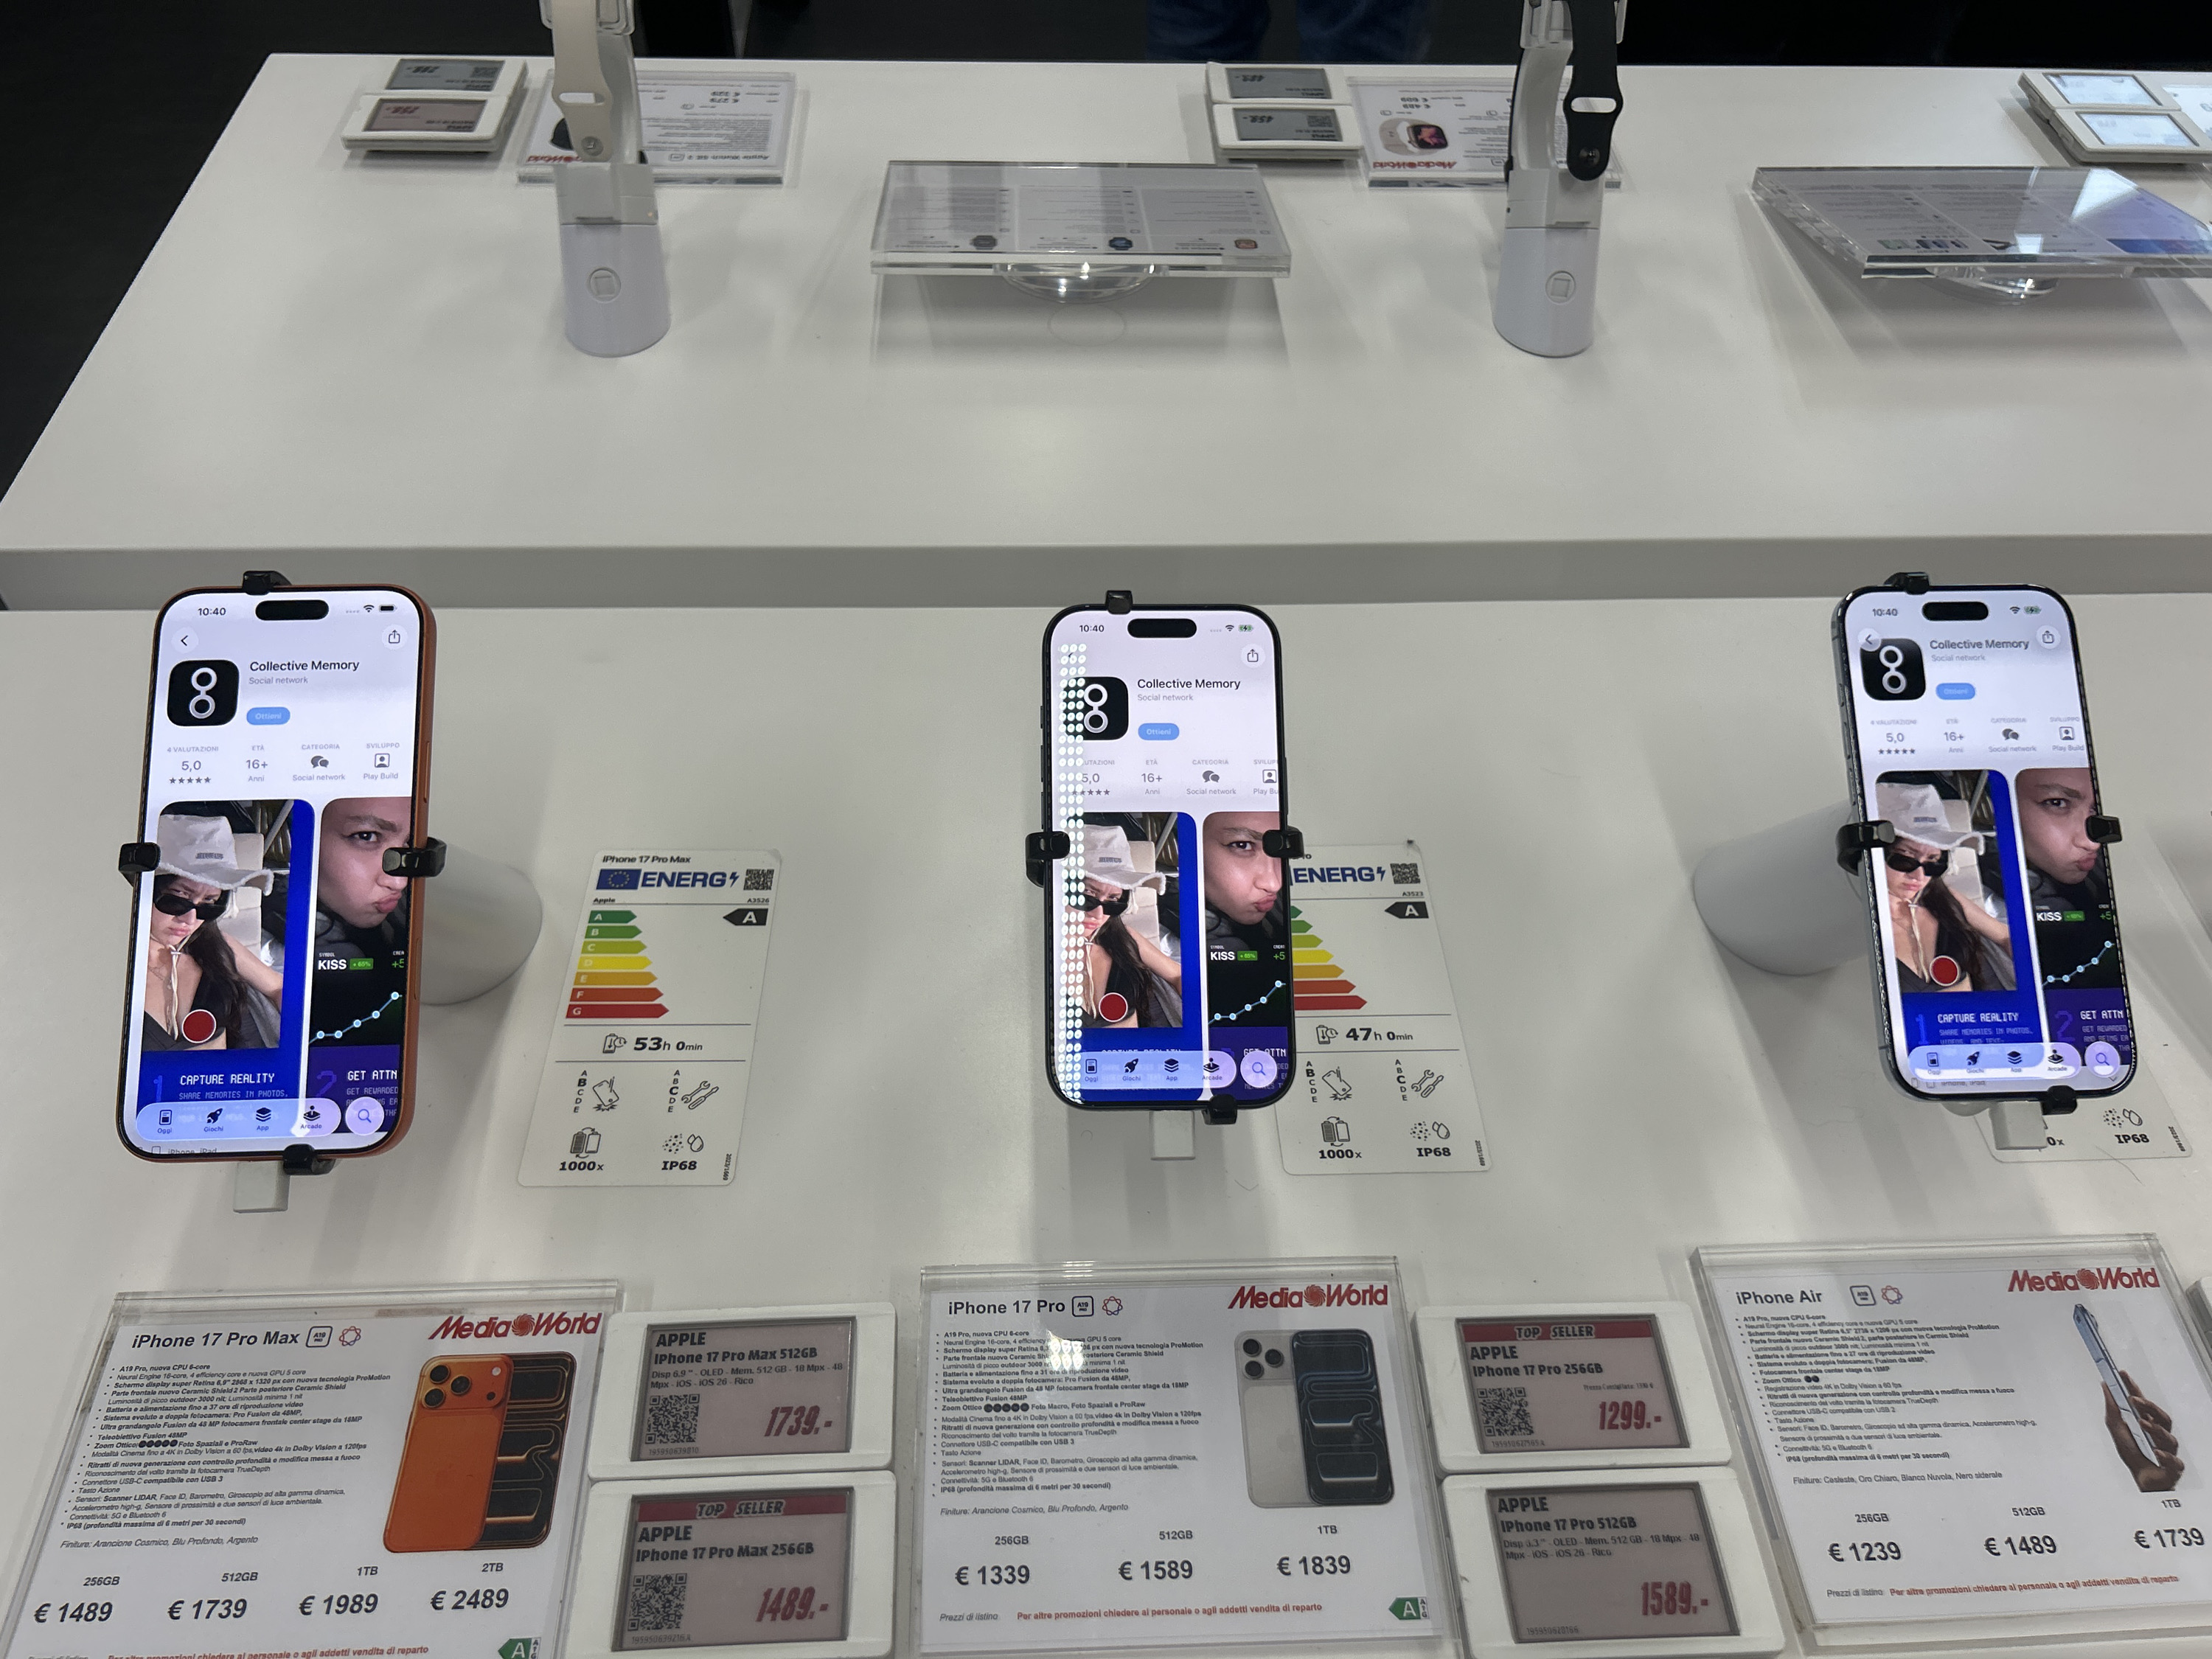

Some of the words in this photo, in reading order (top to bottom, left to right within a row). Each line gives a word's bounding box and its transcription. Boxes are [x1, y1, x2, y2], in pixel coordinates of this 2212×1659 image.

[198, 608, 226, 616] 10:40
[1873, 608, 1898, 616] 10:40
[1930, 640, 1983, 649] Collective
[1985, 640, 2029, 650] Memory
[250, 661, 307, 671] Collective
[312, 661, 359, 671] Memory
[1138, 679, 1192, 688] Collective
[1196, 679, 1240, 689] Memory
[182, 761, 201, 772] 5,0
[246, 759, 268, 769] 16+
[641, 872, 726, 887] ENERG
[1293, 867, 1374, 883] ENERG
[742, 911, 757, 923] A
[1405, 905, 1419, 916] A
[1211, 952, 1235, 960] KISS
[319, 959, 347, 970] KISS
[1938, 1014, 1975, 1023] CAPTURE
[1980, 1012, 2018, 1022] REALITY
[181, 1074, 224, 1085] CAPTURE
[231, 1074, 274, 1083] REALITY
[348, 1071, 366, 1080] GET
[372, 1070, 397, 1079] ATTN
[2115, 1134, 2149, 1144] IP68
[1416, 1147, 1451, 1156] IP68
[661, 1161, 697, 1170] IP68
[1736, 1292, 1794, 1304] iPhone
[1800, 1290, 1821, 1302] Air
[949, 1301, 1006, 1314] iPhone
[1013, 1301, 1031, 1312] 17
[1037, 1300, 1065, 1312] Pro
[1517, 1327, 1540, 1338] TOP
[1551, 1326, 1594, 1338] SELLER
[132, 1335, 195, 1348] iPhone
[203, 1333, 223, 1346] 17
[226, 1332, 257, 1345] Pro
[263, 1332, 299, 1344] Max
[655, 1332, 706, 1347] APPLE
[707, 1352, 719, 1362] 17
[722, 1352, 745, 1361] Pro
[748, 1350, 777, 1360] Max
[780, 1348, 817, 1359] 512GB
[1470, 1346, 1518, 1360] APPLE
[1523, 1365, 1534, 1375] 17
[1538, 1365, 1561, 1374] Pro
[1564, 1363, 1603, 1374] 256GB
[698, 1503, 725, 1516] TOP
[736, 1500, 784, 1515] SELLER
[1498, 1497, 1548, 1512] APPLE
[1855, 1514, 1889, 1523] 256GB
[2012, 1507, 2045, 1516] 512GB
[2161, 1499, 2181, 1508] 1TB
[1554, 1519, 1566, 1531] 17
[1570, 1519, 1594, 1530] Pro
[1597, 1517, 1636, 1529] 512GB
[638, 1526, 692, 1543] APPLE
[995, 1536, 1029, 1545] 256GB
[1160, 1530, 1193, 1540] 512GB
[1318, 1526, 1337, 1534] 1TB
[2134, 1531, 2149, 1548] €
[2154, 1528, 2204, 1547] 1739
[692, 1547, 706, 1559] 17
[709, 1547, 734, 1558] Pro
[737, 1545, 768, 1557] Max
[771, 1543, 814, 1556] 256GB
[1828, 1543, 1844, 1562] €
[1849, 1542, 1901, 1561] 1239
[1984, 1538, 2000, 1556] €
[2005, 1536, 2056, 1555] 1489
[358, 1566, 378, 1576] 1TB
[482, 1563, 503, 1572] 2TB
[1119, 1562, 1133, 1580] €
[1141, 1560, 1192, 1579] 1589
[1277, 1557, 1291, 1576] €
[1299, 1556, 1350, 1575] 1839
[83, 1576, 119, 1586] 256GB
[222, 1572, 258, 1582] 512GB
[956, 1566, 969, 1585] €
[978, 1565, 1029, 1585] 1339
[299, 1596, 315, 1615] €
[324, 1594, 378, 1614] 1989
[431, 1591, 446, 1610] €
[452, 1588, 508, 1610] 2489
[34, 1604, 51, 1623] €
[59, 1602, 112, 1622] 1489
[168, 1601, 184, 1620] €
[193, 1599, 247, 1619] 1739
[1054, 1610, 1101, 1620] promozioni
[1104, 1609, 1139, 1617] chiedere
[1152, 1607, 1192, 1617] personale
[1203, 1606, 1217, 1615] agli
[1220, 1605, 1248, 1613] addetti
[1250, 1604, 1280, 1613] vendita
[1283, 1604, 1290, 1612] di
[1293, 1604, 1322, 1613] reparto
